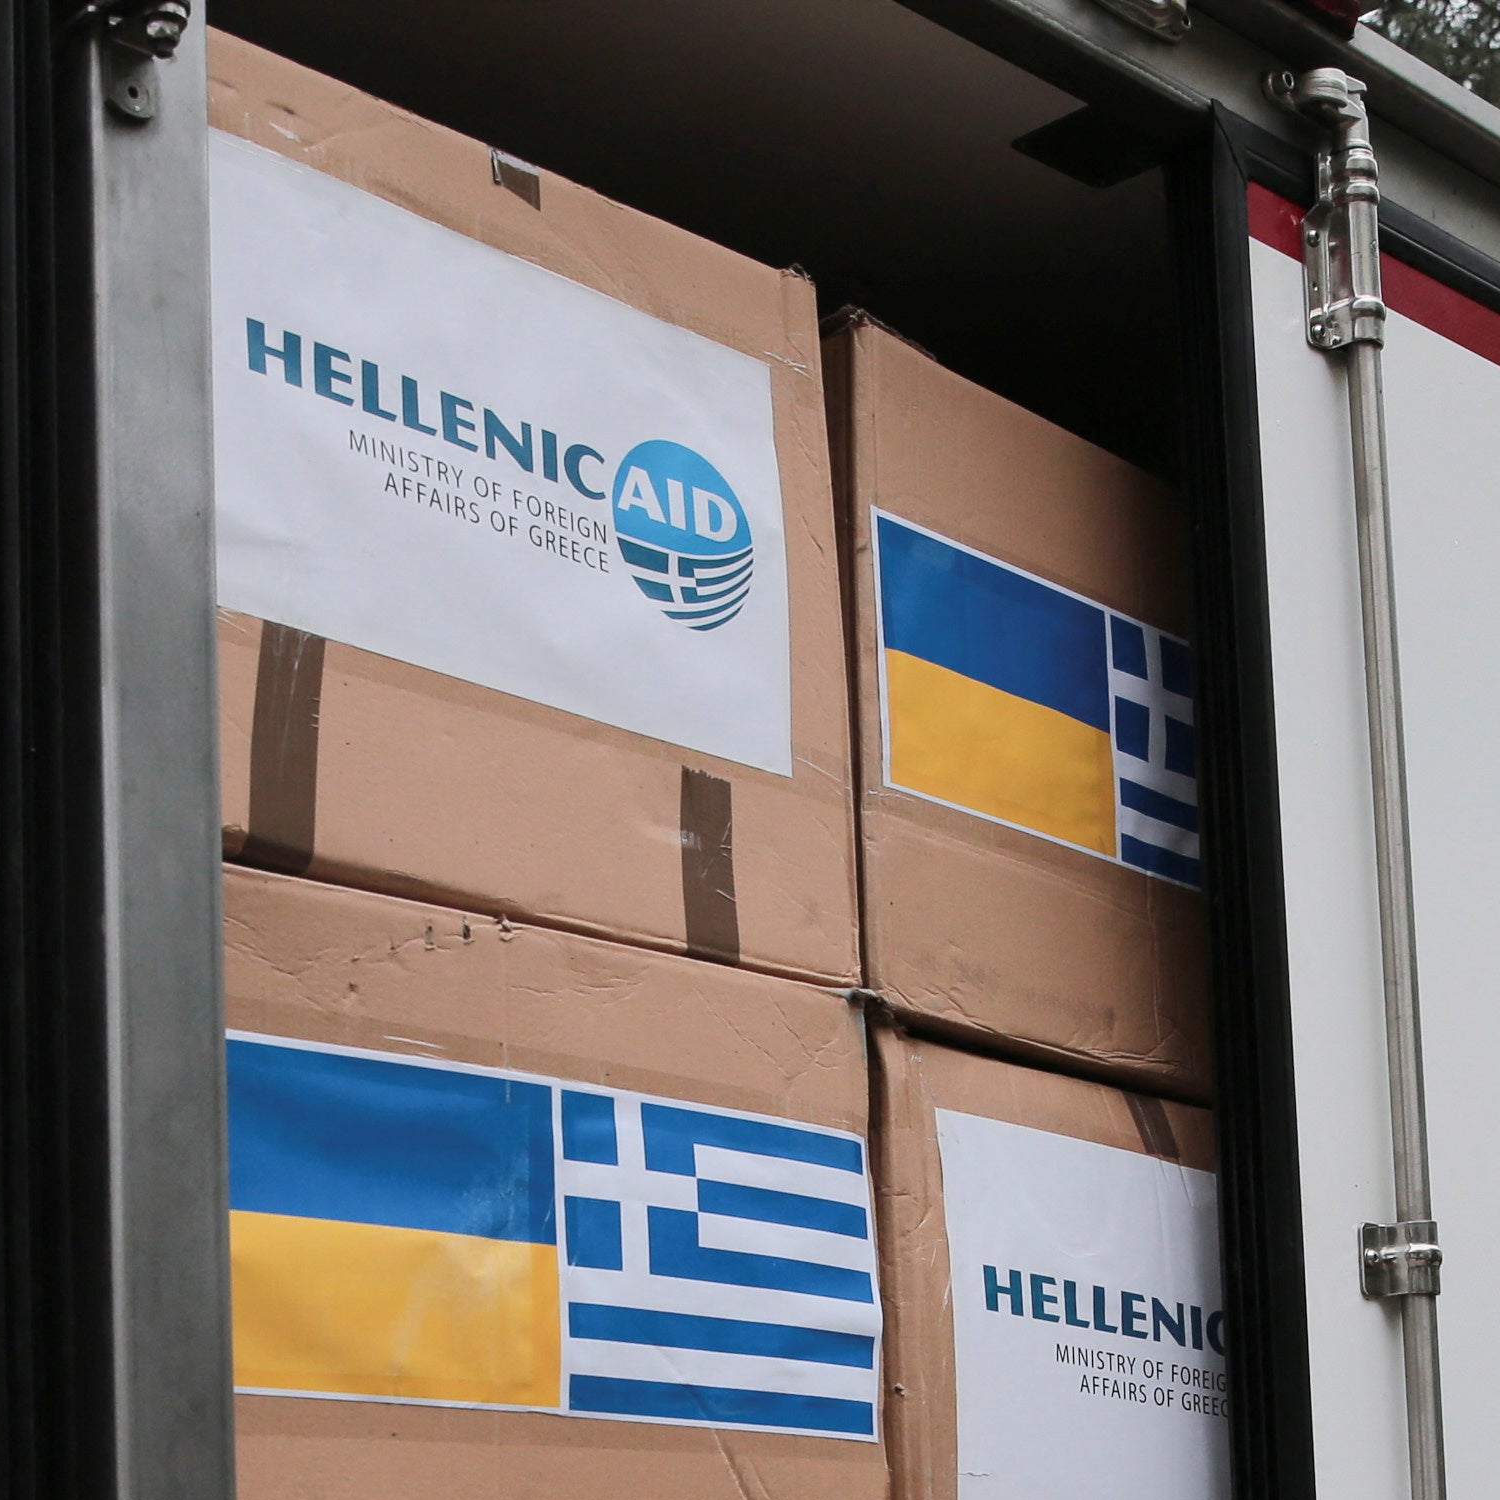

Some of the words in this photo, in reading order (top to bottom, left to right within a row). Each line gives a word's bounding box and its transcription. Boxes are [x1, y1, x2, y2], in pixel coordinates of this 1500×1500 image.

[245, 316, 607, 502] HELLENIC
[617, 465, 739, 544] AID
[349, 428, 464, 487] MINISTRY
[474, 475, 504, 504] OF
[514, 489, 607, 545] FOREIGN
[384, 473, 481, 525] AFFAIRS
[490, 509, 520, 537] OF
[529, 523, 610, 574] GREECE
[1056, 1343, 1136, 1375] MINISTRY
[1143, 1359, 1164, 1380] OF
[1171, 1364, 1226, 1392] FOREIG
[1080, 1374, 1147, 1404] AFFAIRS
[1153, 1387, 1175, 1408] OF
[1181, 1392, 1229, 1418] GREEC
